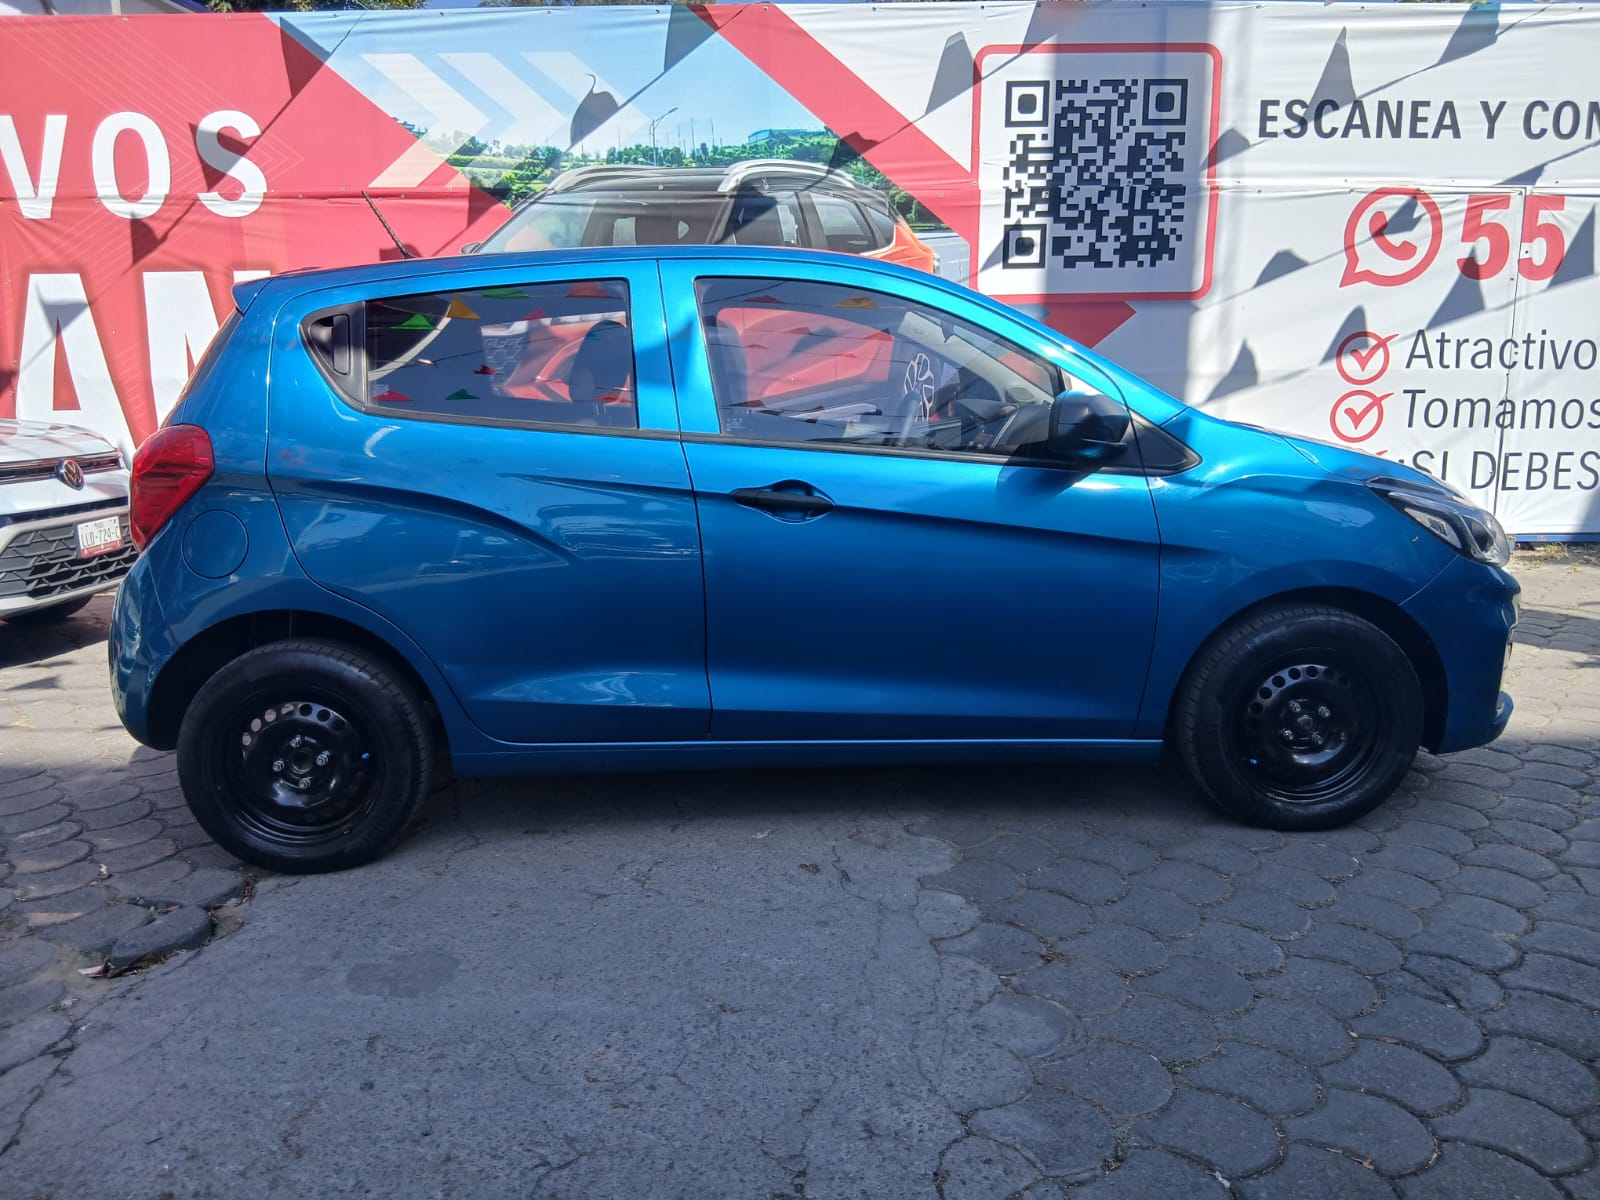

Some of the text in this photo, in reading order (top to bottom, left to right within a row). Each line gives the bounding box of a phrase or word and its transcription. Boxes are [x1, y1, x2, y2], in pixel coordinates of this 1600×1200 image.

[1258, 98, 1461, 139] ESCANEA
[1480, 100, 1507, 140] Y
[1456, 193, 1566, 282] 55
[1404, 329, 1598, 370] Atractivo
[1402, 388, 1600, 430] Tomamos
[1470, 450, 1600, 491] DEBES
